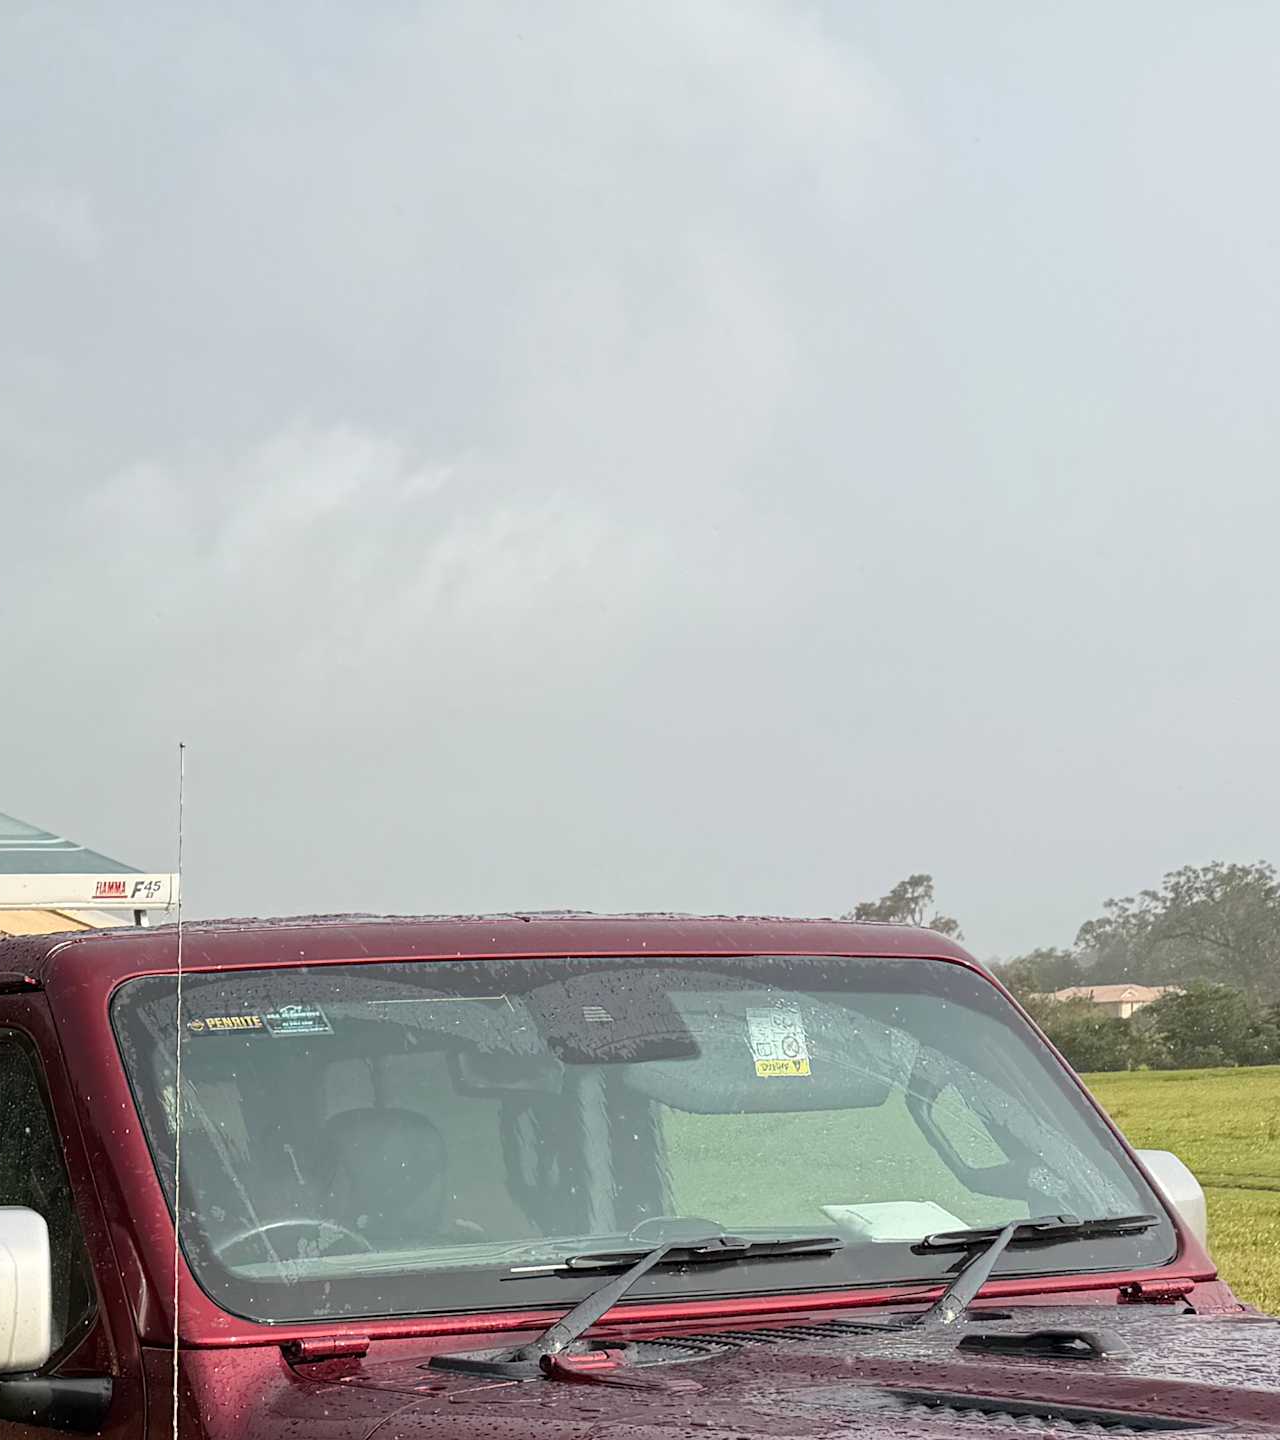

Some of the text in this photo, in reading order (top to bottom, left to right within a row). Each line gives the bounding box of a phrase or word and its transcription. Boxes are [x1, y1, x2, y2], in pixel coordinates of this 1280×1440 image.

[95, 881, 126, 896] FIAMMA
[130, 880, 161, 899] F45
[205, 1015, 263, 1029] PENRITE
